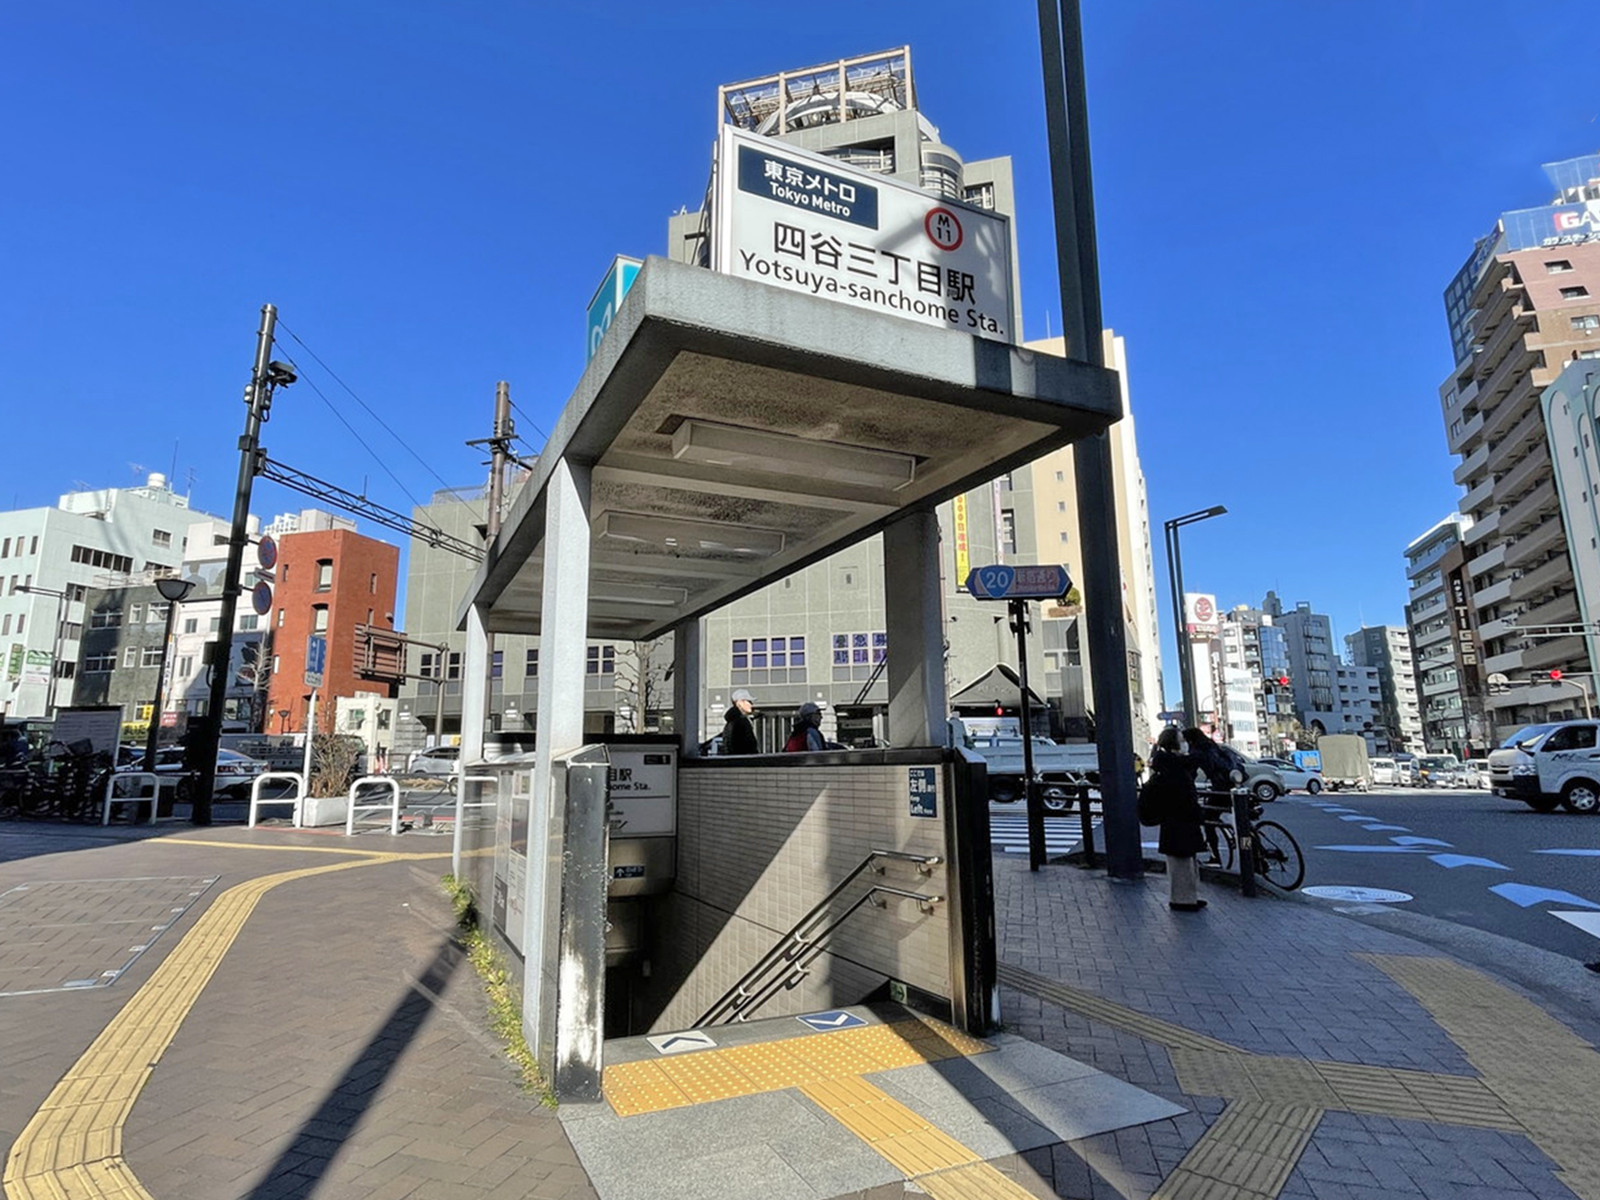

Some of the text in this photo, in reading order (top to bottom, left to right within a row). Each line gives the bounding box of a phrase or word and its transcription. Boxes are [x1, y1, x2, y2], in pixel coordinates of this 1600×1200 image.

[764, 159, 855, 203] 東京メトロ
[769, 181, 851, 217] Tokyo Metro
[937, 214, 950, 228] M
[937, 227, 951, 243] 11
[774, 221, 976, 306] 四谷三丁目駅
[739, 249, 1004, 335] Yotsuya-sanchome Sta.
[986, 571, 1009, 589] 20
[633, 782, 651, 791] Sta.
